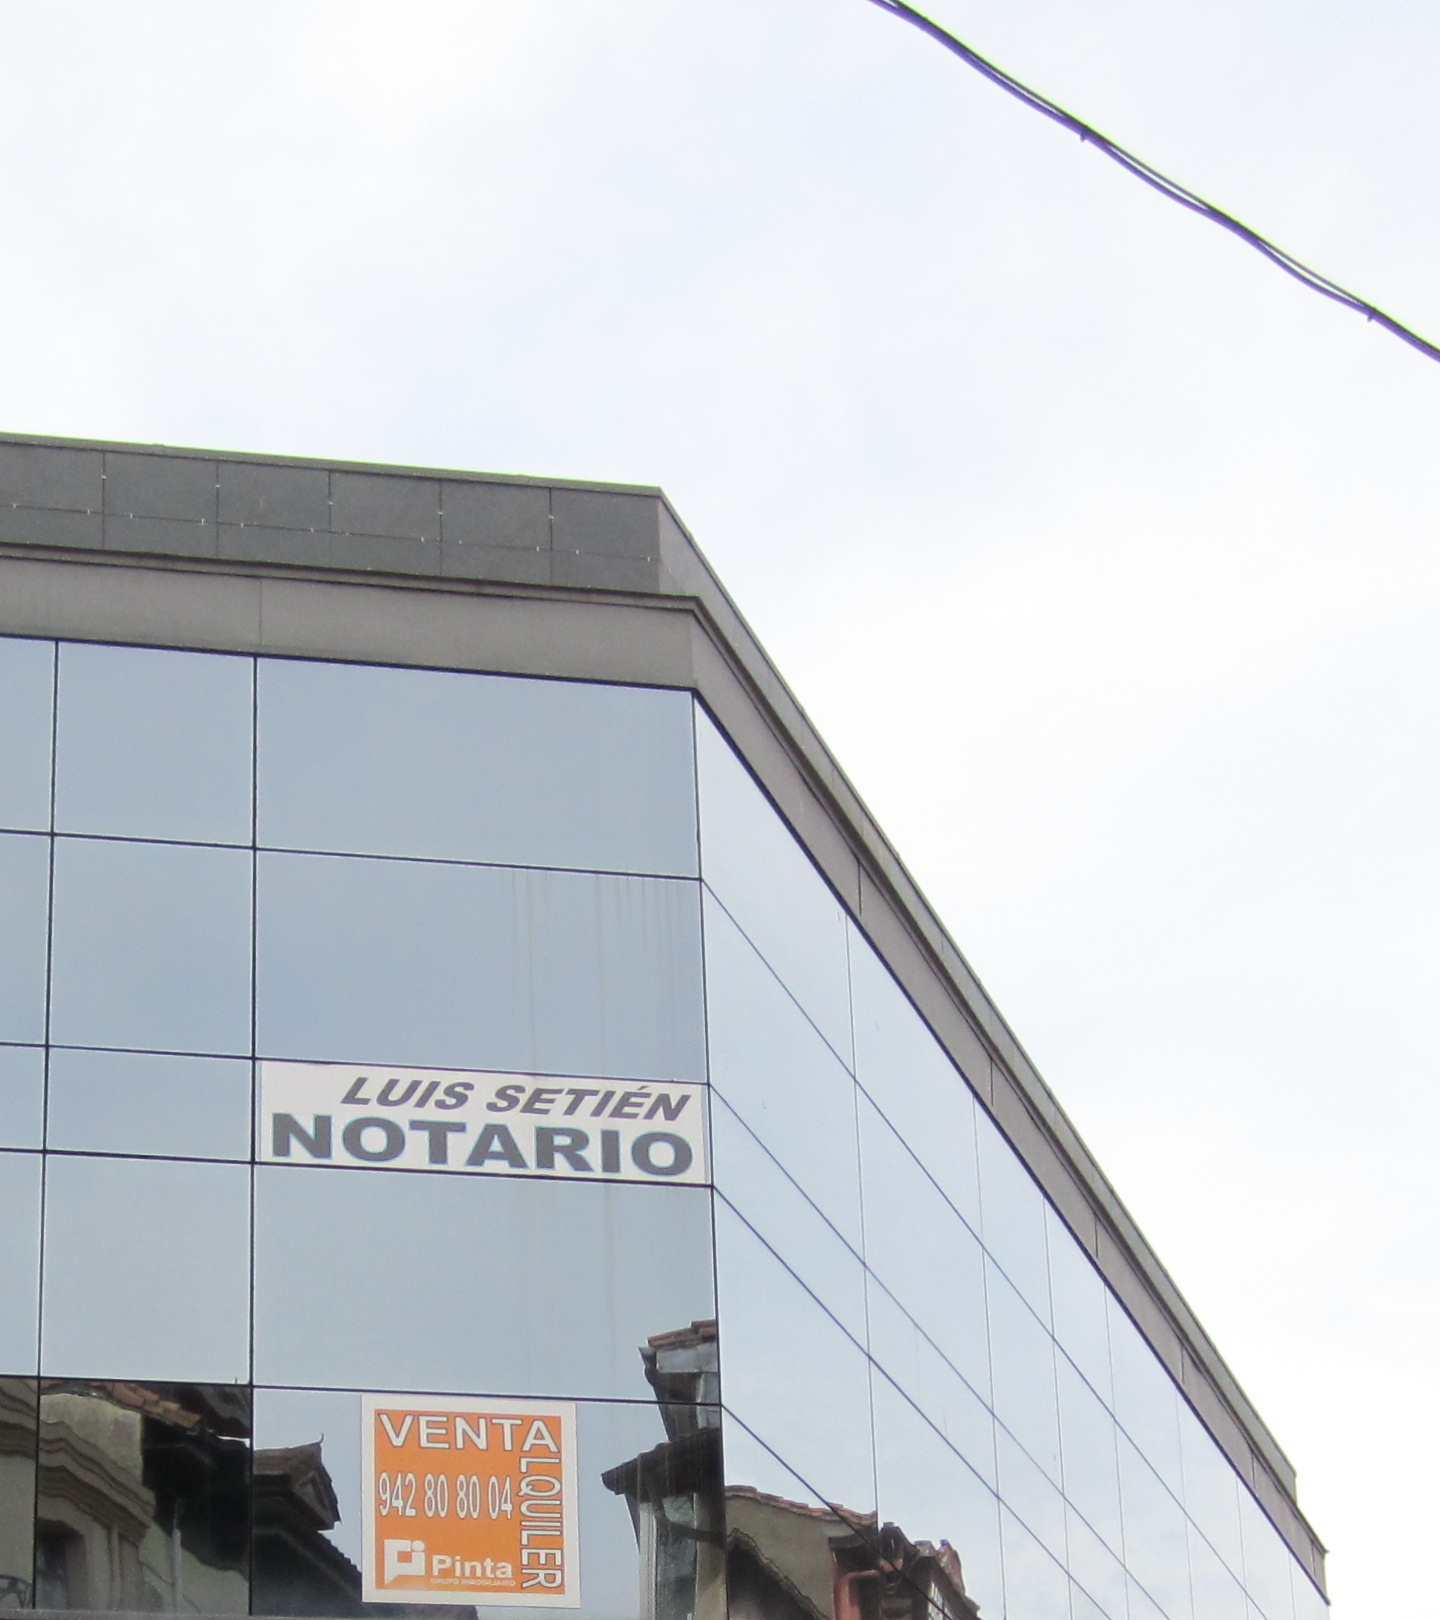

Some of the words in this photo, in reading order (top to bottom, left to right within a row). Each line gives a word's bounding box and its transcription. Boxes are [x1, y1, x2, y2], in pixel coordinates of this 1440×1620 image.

[341, 1076, 475, 1110] LUIS
[485, 1085, 691, 1122] SETIÉN
[271, 1113, 693, 1176] NOTARIO
[377, 1412, 560, 1453] VENTA
[378, 1471, 417, 1517] 942
[424, 1472, 449, 1518] 80
[456, 1473, 481, 1519] 80
[488, 1474, 513, 1520] 04
[431, 1554, 514, 1579] Pinta
